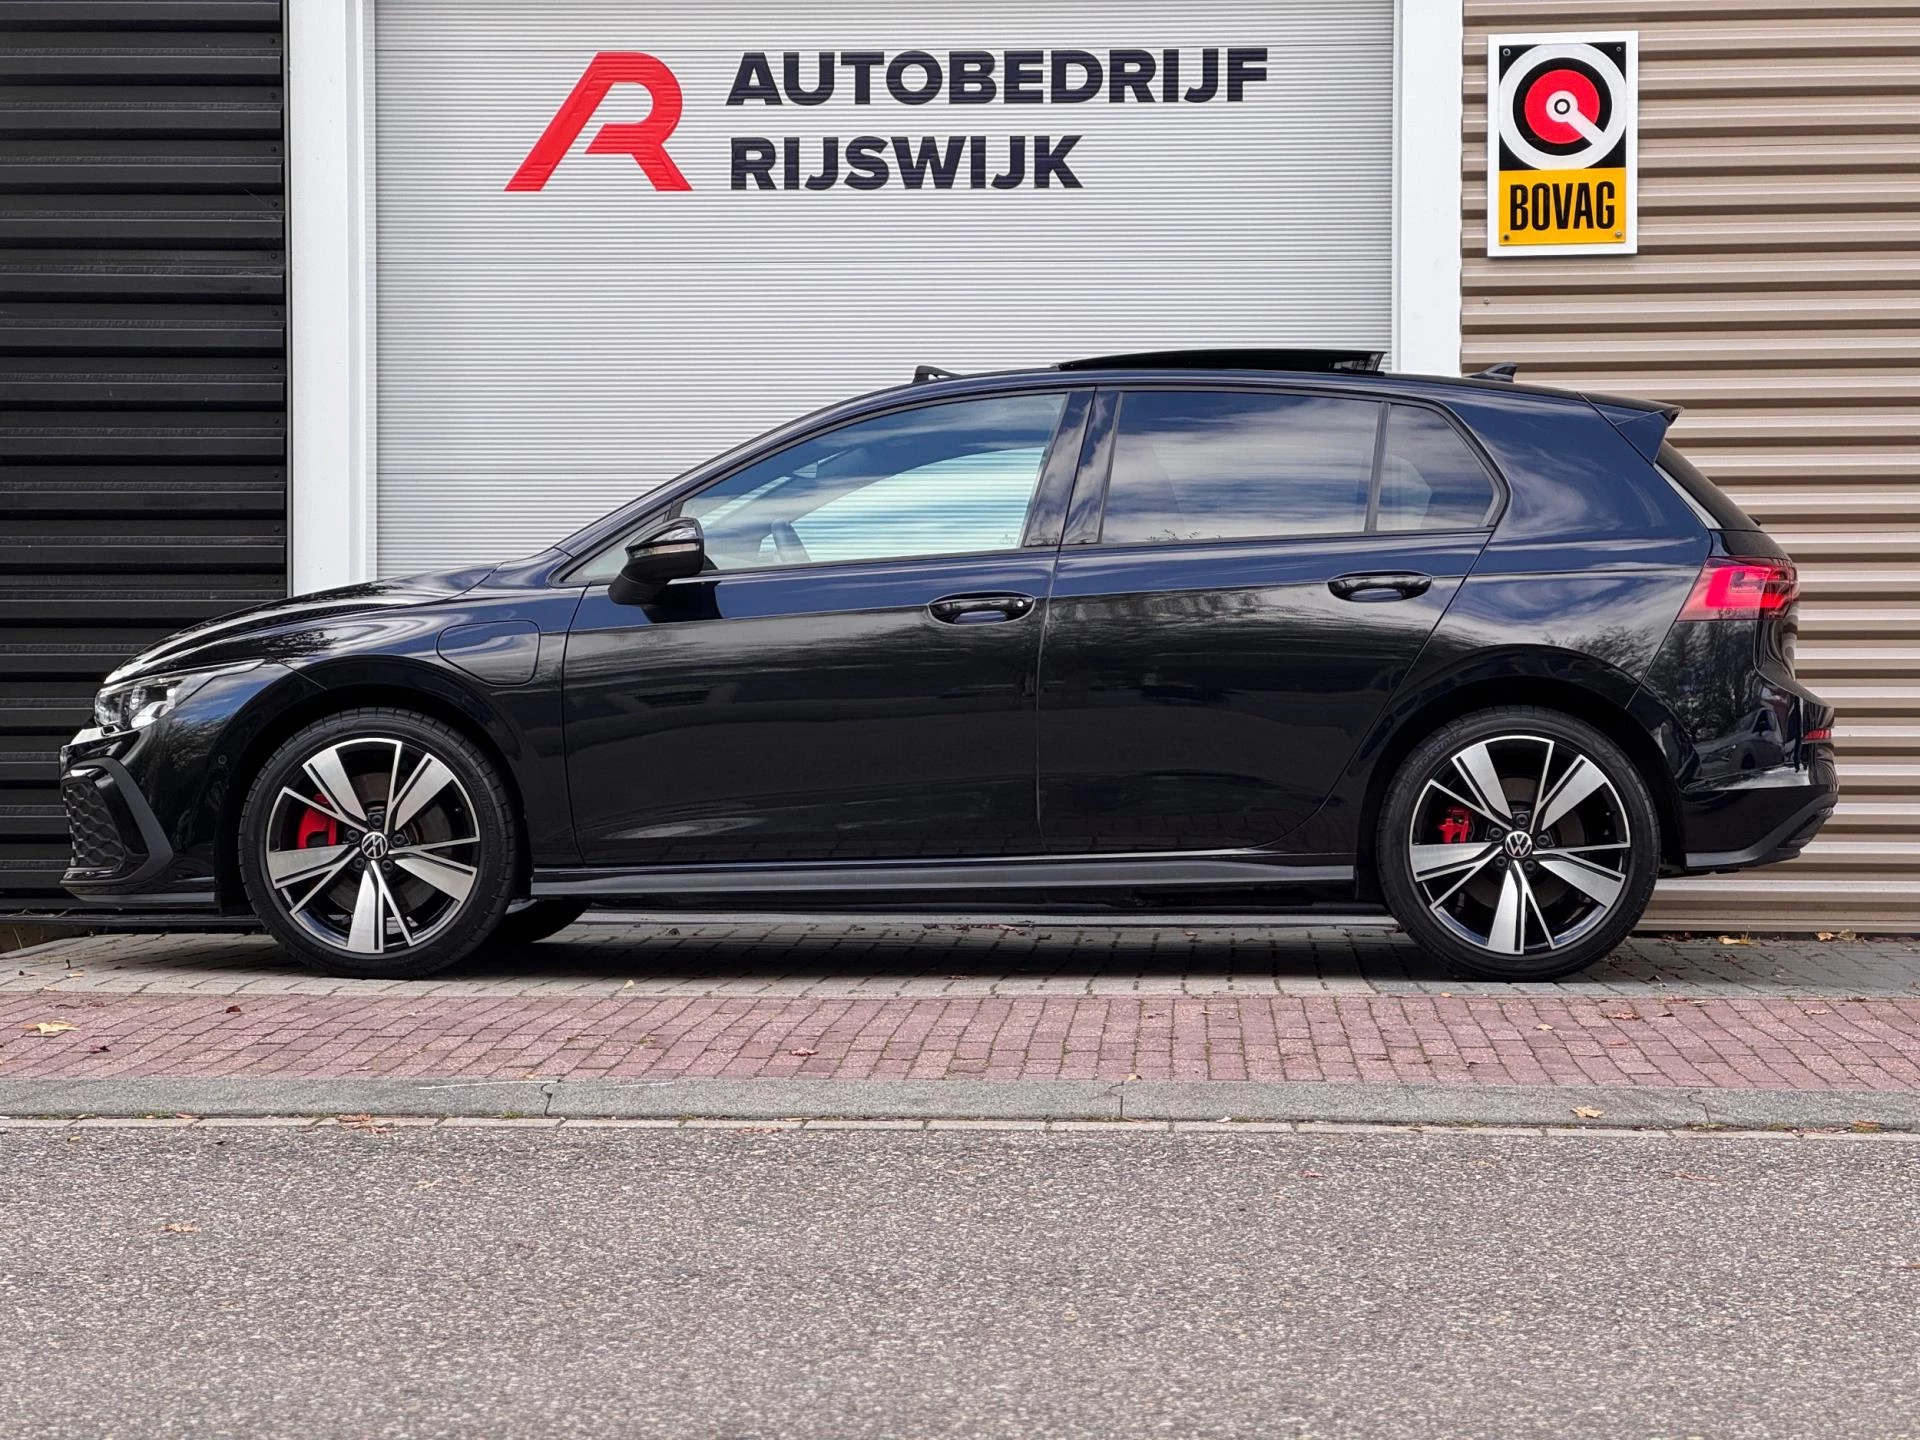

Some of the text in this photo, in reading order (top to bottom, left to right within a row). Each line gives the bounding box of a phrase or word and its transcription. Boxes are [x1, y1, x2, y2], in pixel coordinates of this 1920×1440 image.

[727, 48, 1268, 106] AUTOBEDRIJF
[731, 136, 1084, 191] RIJSWIJK
[1510, 181, 1615, 231] BOVAG
